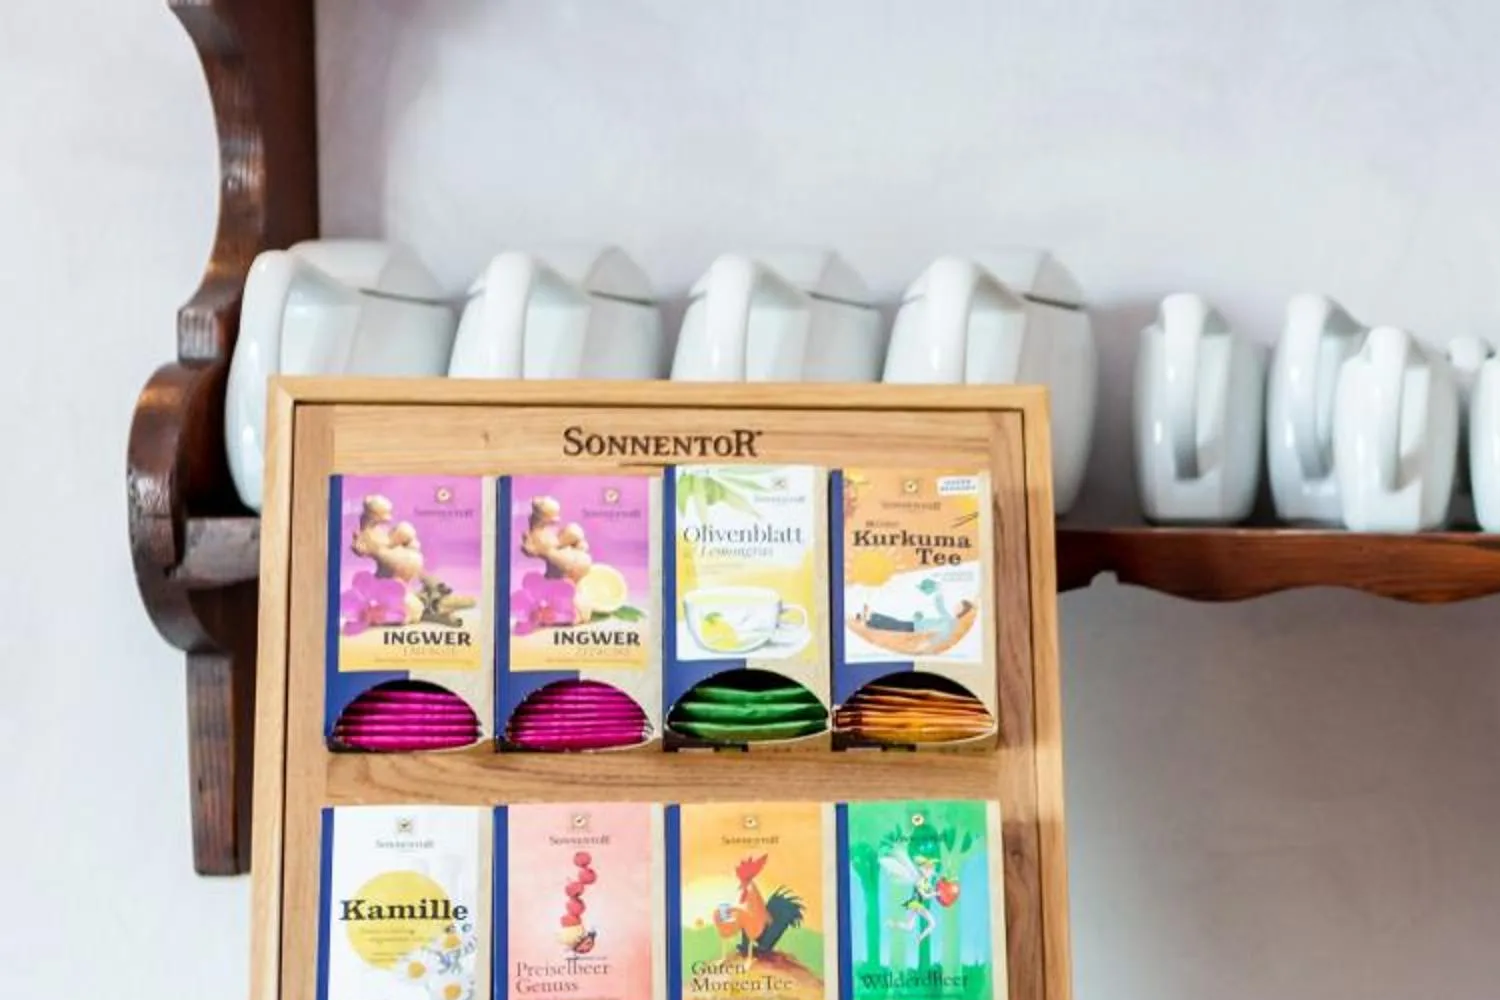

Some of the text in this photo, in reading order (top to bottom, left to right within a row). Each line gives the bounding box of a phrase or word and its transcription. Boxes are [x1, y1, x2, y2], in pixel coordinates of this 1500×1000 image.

[683, 523, 802, 546] Olivenblatt
[853, 529, 972, 549] Kurkuma
[915, 548, 962, 566] Tee
[383, 631, 472, 647] INGWER
[553, 631, 640, 647] INGWER
[339, 899, 469, 921] Kamille
[691, 960, 745, 976] Guten
[515, 979, 579, 995] Genuss
